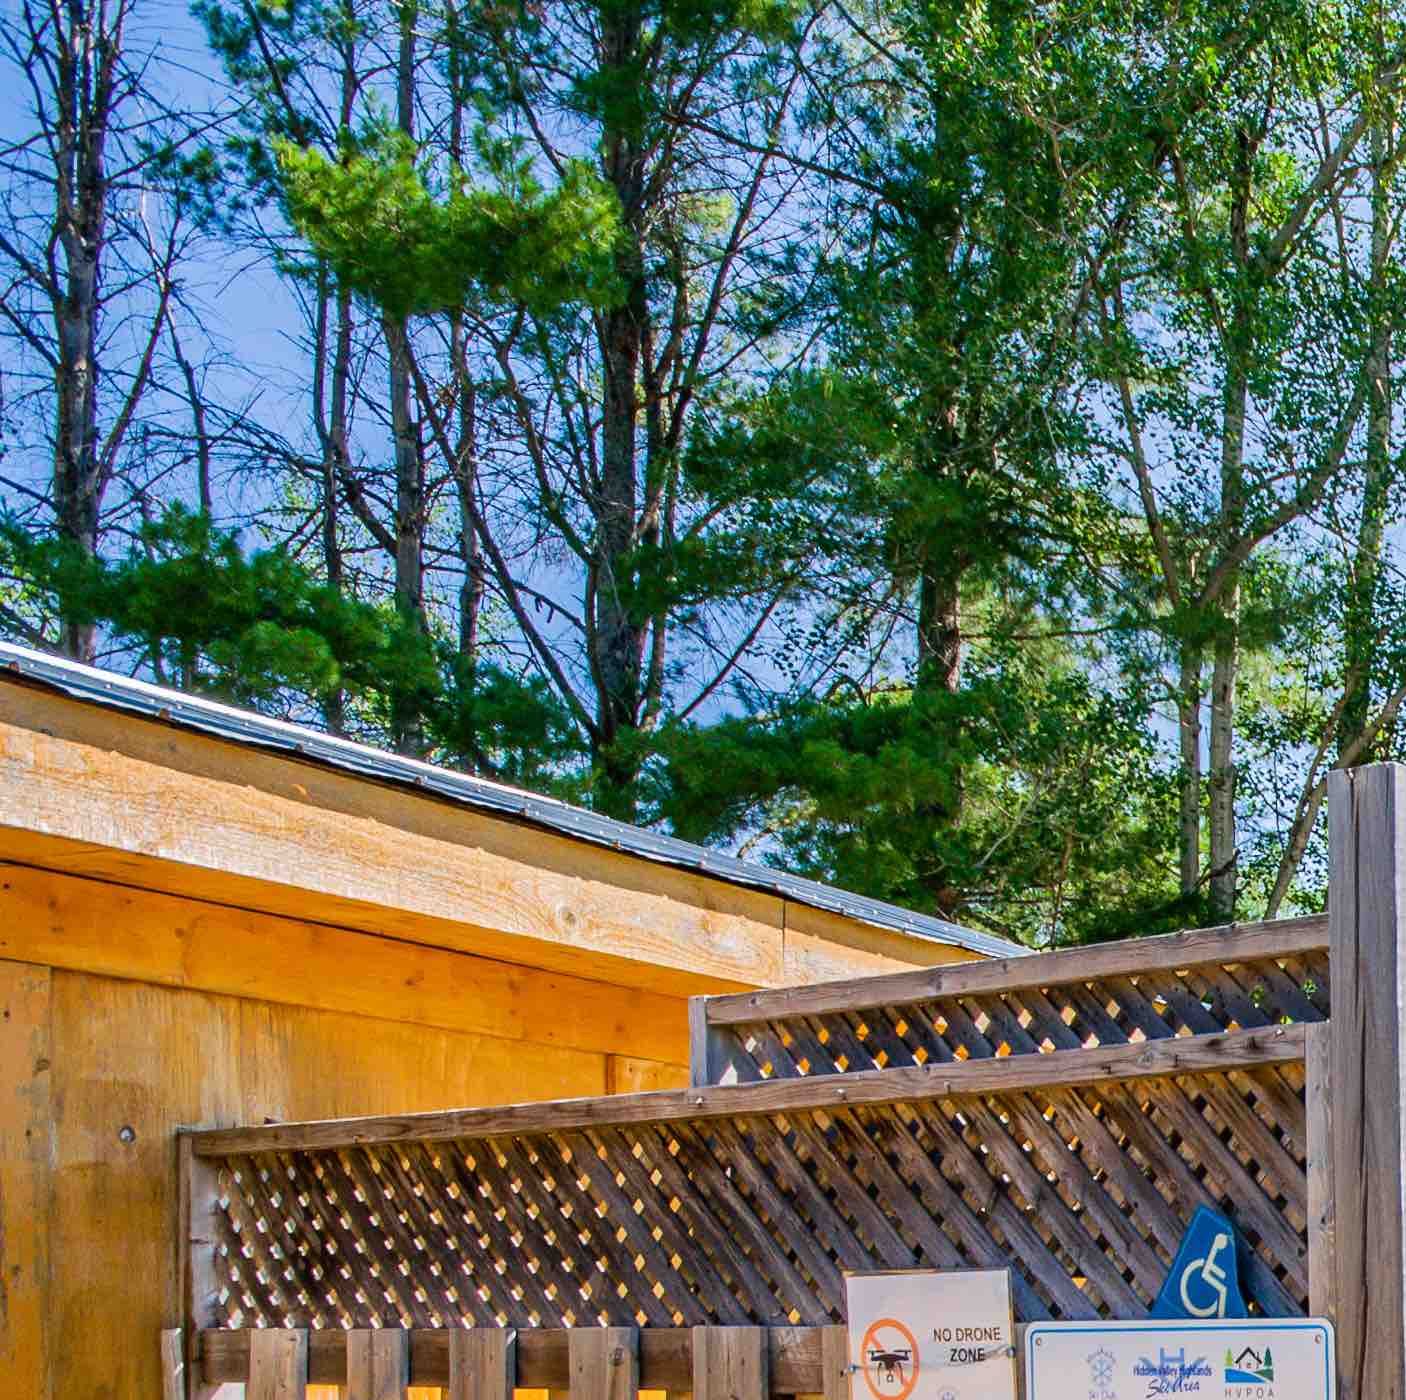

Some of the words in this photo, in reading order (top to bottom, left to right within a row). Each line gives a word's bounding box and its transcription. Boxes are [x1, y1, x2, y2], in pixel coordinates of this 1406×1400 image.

[933, 1328, 951, 1342] NO
[956, 1327, 1000, 1342] DRONE
[950, 1348, 986, 1362] ZONE
